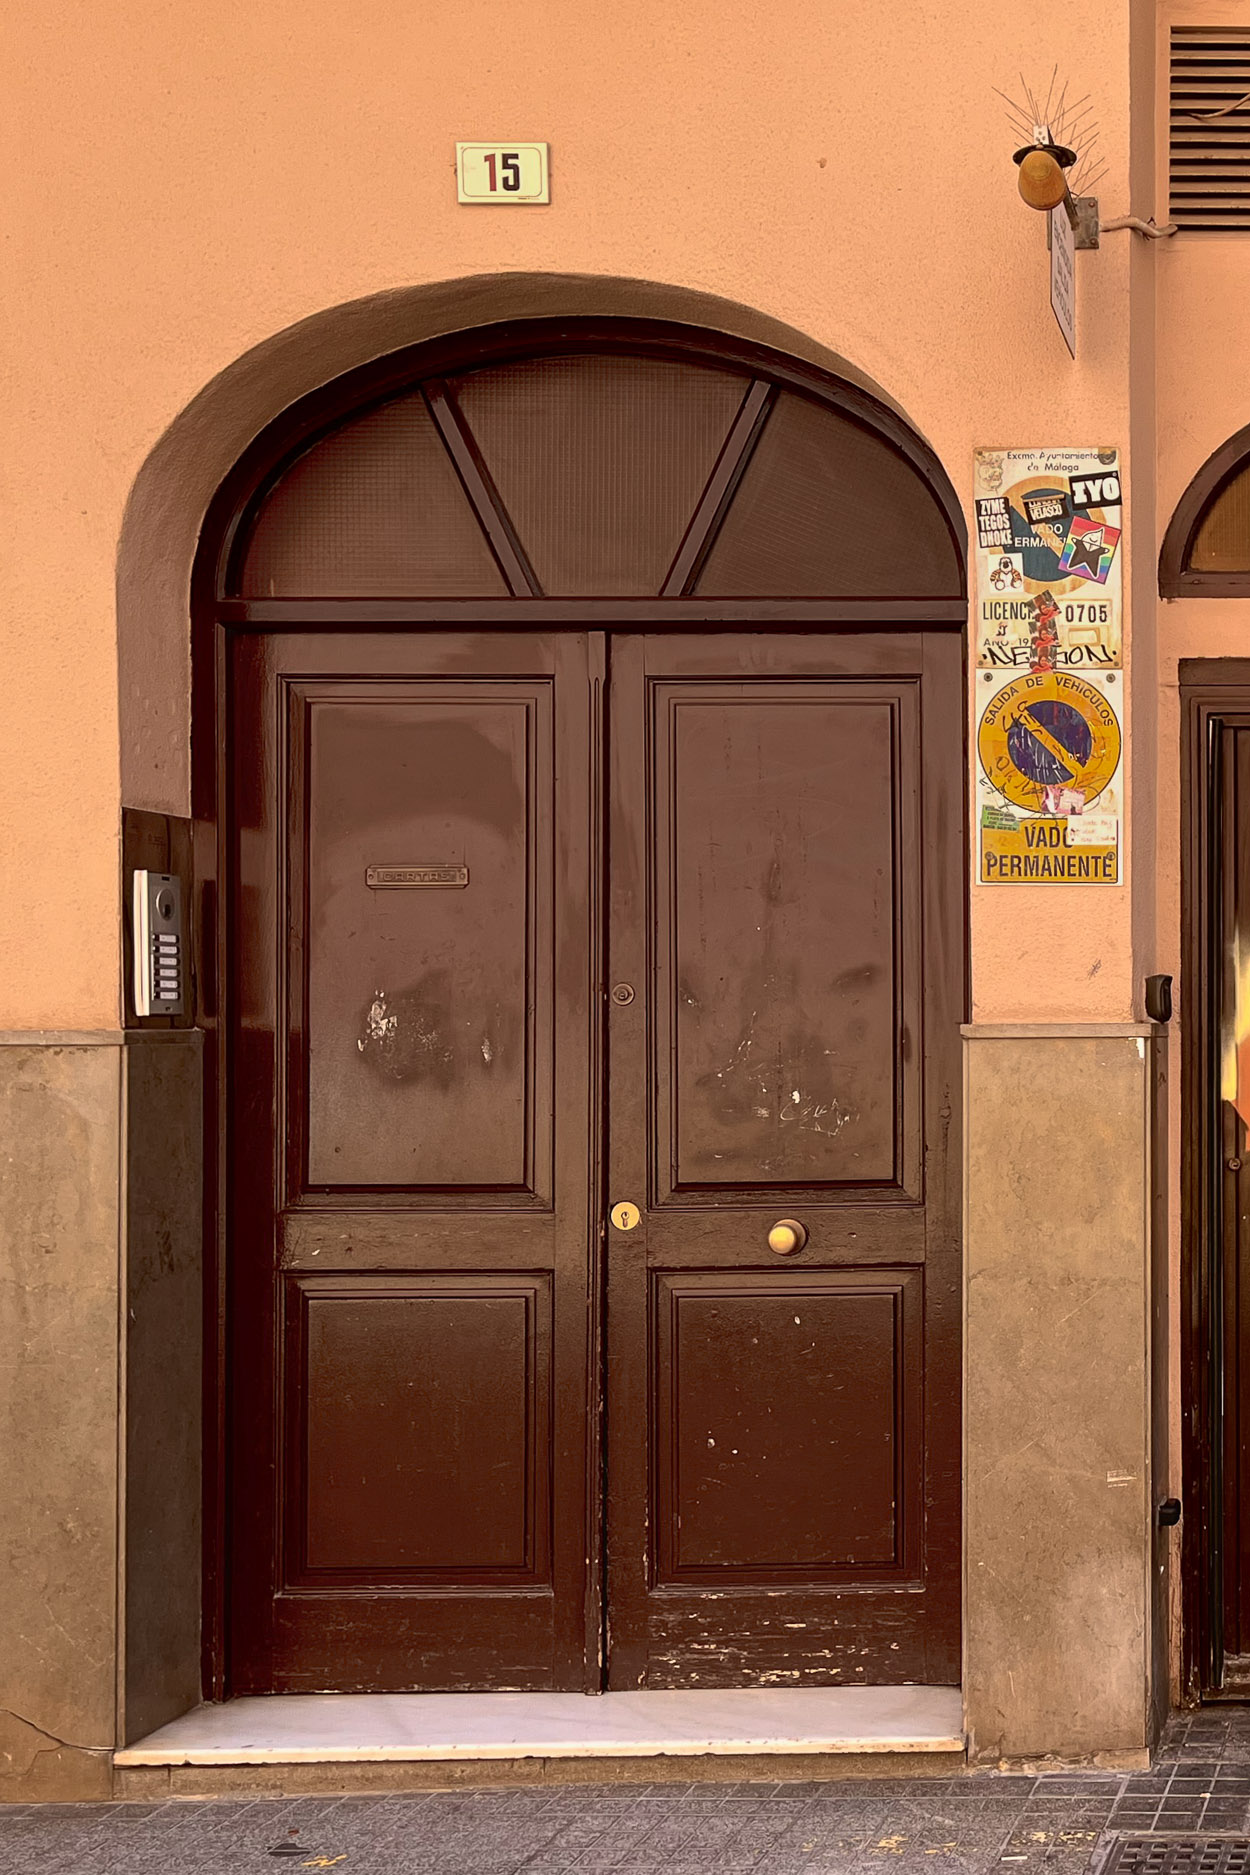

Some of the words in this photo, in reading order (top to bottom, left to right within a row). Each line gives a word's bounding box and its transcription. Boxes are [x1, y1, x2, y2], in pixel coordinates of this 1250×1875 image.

[483, 153, 520, 192] 15
[980, 499, 1005, 515] ZYME
[979, 514, 1010, 531] TEGOS
[1065, 604, 1108, 623] 0705
[984, 686, 1019, 726] SALIDA
[1025, 676, 1043, 688] DE
[1055, 676, 1114, 727] VEHICULOS
[986, 855, 1113, 877] PERMANENTE
